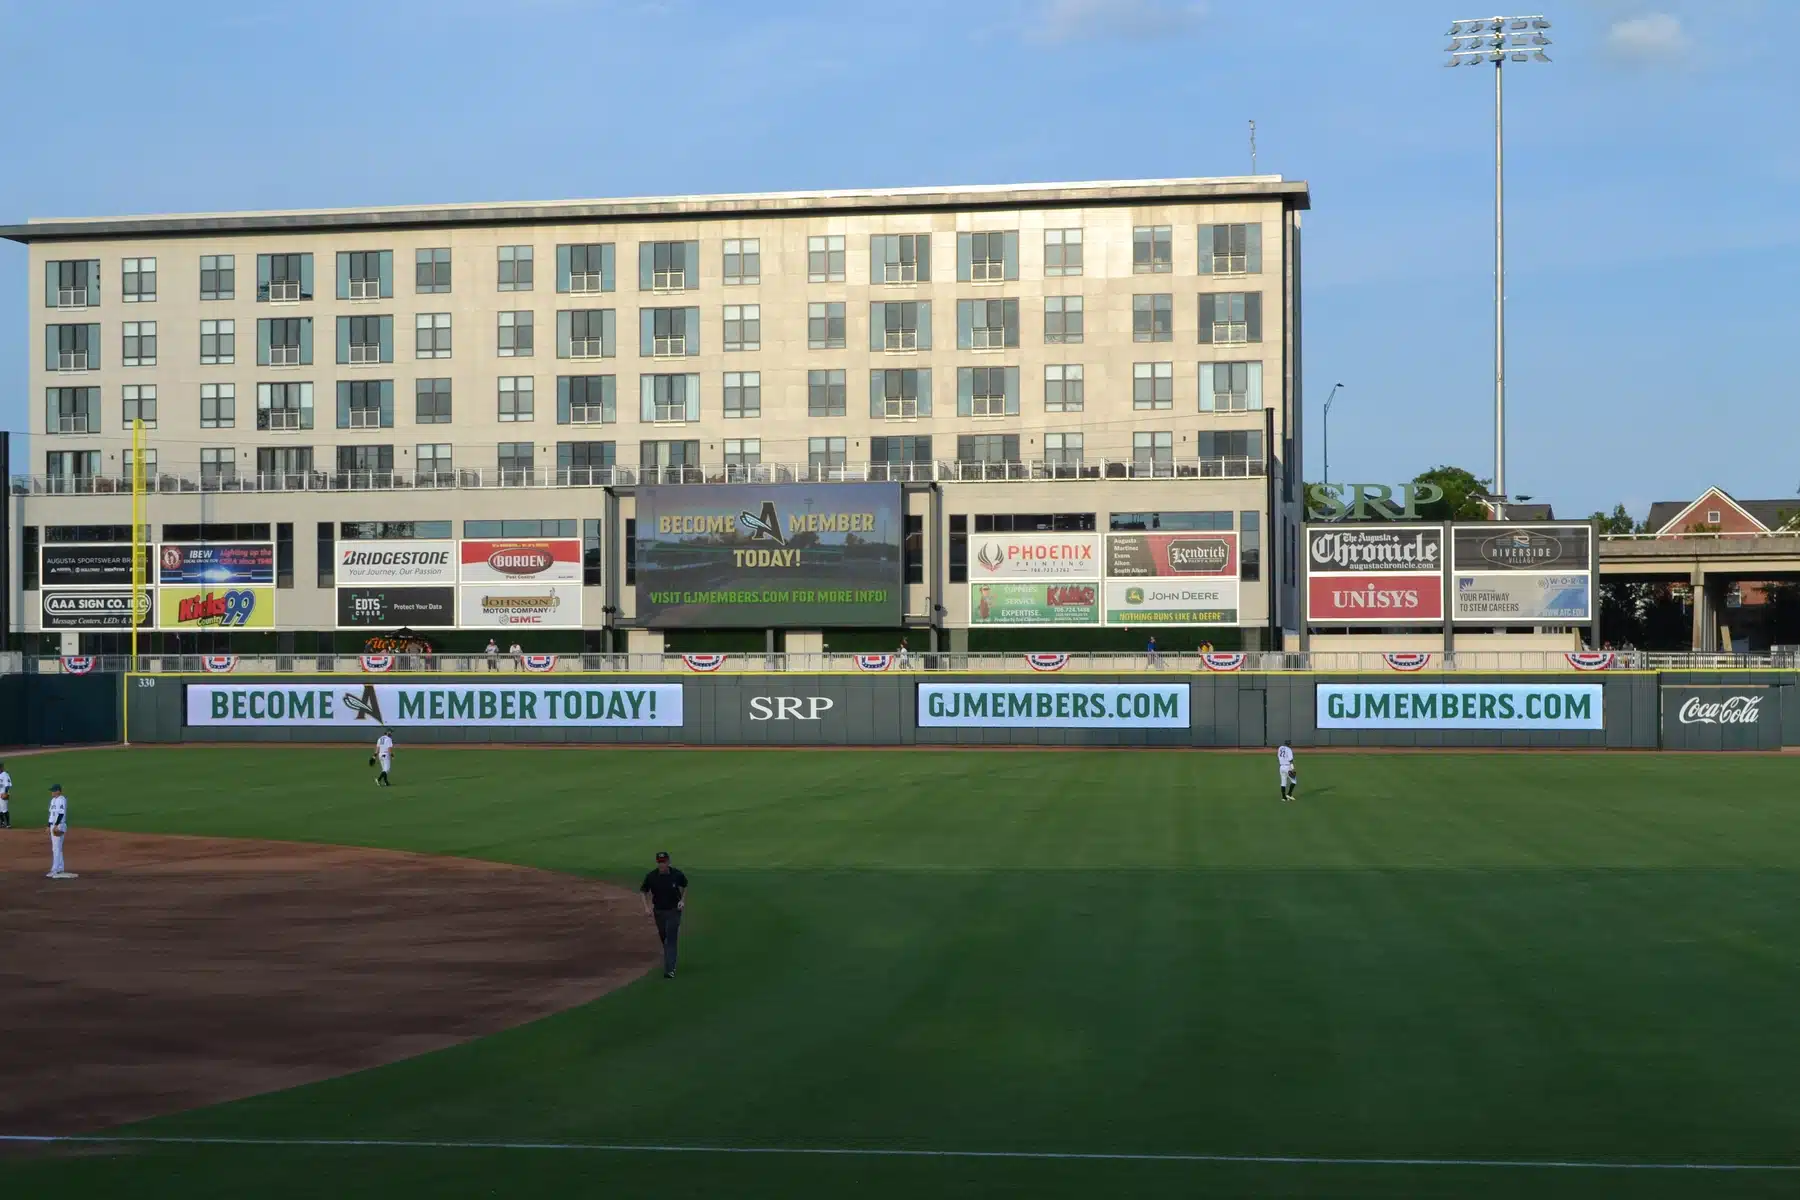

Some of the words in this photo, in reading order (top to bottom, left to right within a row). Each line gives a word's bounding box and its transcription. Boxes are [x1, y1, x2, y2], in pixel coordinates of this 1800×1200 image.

[1307, 483, 1443, 519] SRP
[659, 515, 736, 534] BECOME
[788, 513, 875, 533] MEMBER
[1342, 532, 1357, 542] The
[1358, 532, 1392, 543] Augusta
[190, 550, 213, 559] IBEW
[1008, 544, 1092, 559] PHOENIX
[1172, 545, 1226, 564] Kendrick
[1311, 532, 1438, 566] Chronicle
[1492, 548, 1551, 557] RIVERSIDE
[342, 551, 449, 565] BRIDGESTONE
[496, 555, 544, 567] BORDEN
[733, 549, 801, 567] TODAY!
[349, 568, 365, 576] Your
[415, 567, 442, 575] Passion
[1350, 561, 1434, 570] augustachronicle.com
[482, 596, 548, 607] JOHNSON
[650, 592, 681, 604] VISIT
[683, 591, 789, 604] GJMEMBERS.COM
[792, 590, 813, 603] FOR
[817, 590, 852, 603] MORE
[855, 590, 887, 602] INFO!
[1148, 592, 1179, 600] JOHN
[1182, 591, 1219, 600] DEERE
[1460, 593, 1478, 601] YOUR
[1479, 592, 1510, 601] PATHWAY
[51, 600, 76, 609] AAA
[78, 599, 104, 609] SIGN
[107, 599, 125, 608] CO.
[178, 592, 226, 623] Kicks
[221, 588, 256, 626] 99
[355, 599, 380, 610] EDTS
[1460, 604, 1468, 612] TO
[1470, 604, 1488, 612] STEM
[1489, 603, 1519, 611] CAREERS
[1120, 612, 1153, 620] NOTHING
[1154, 612, 1173, 620] RUNS
[1175, 612, 1190, 620] LIKE
[1192, 612, 1198, 620] A
[138, 678, 155, 688] 330
[211, 691, 334, 719] BECOME
[398, 690, 537, 719] MEMBER
[544, 690, 657, 719] TODAY!
[749, 696, 834, 720] SRP
[928, 692, 1179, 718] GJMEMBERS.COM
[1328, 694, 1591, 719] GJMEMBERS.COM
